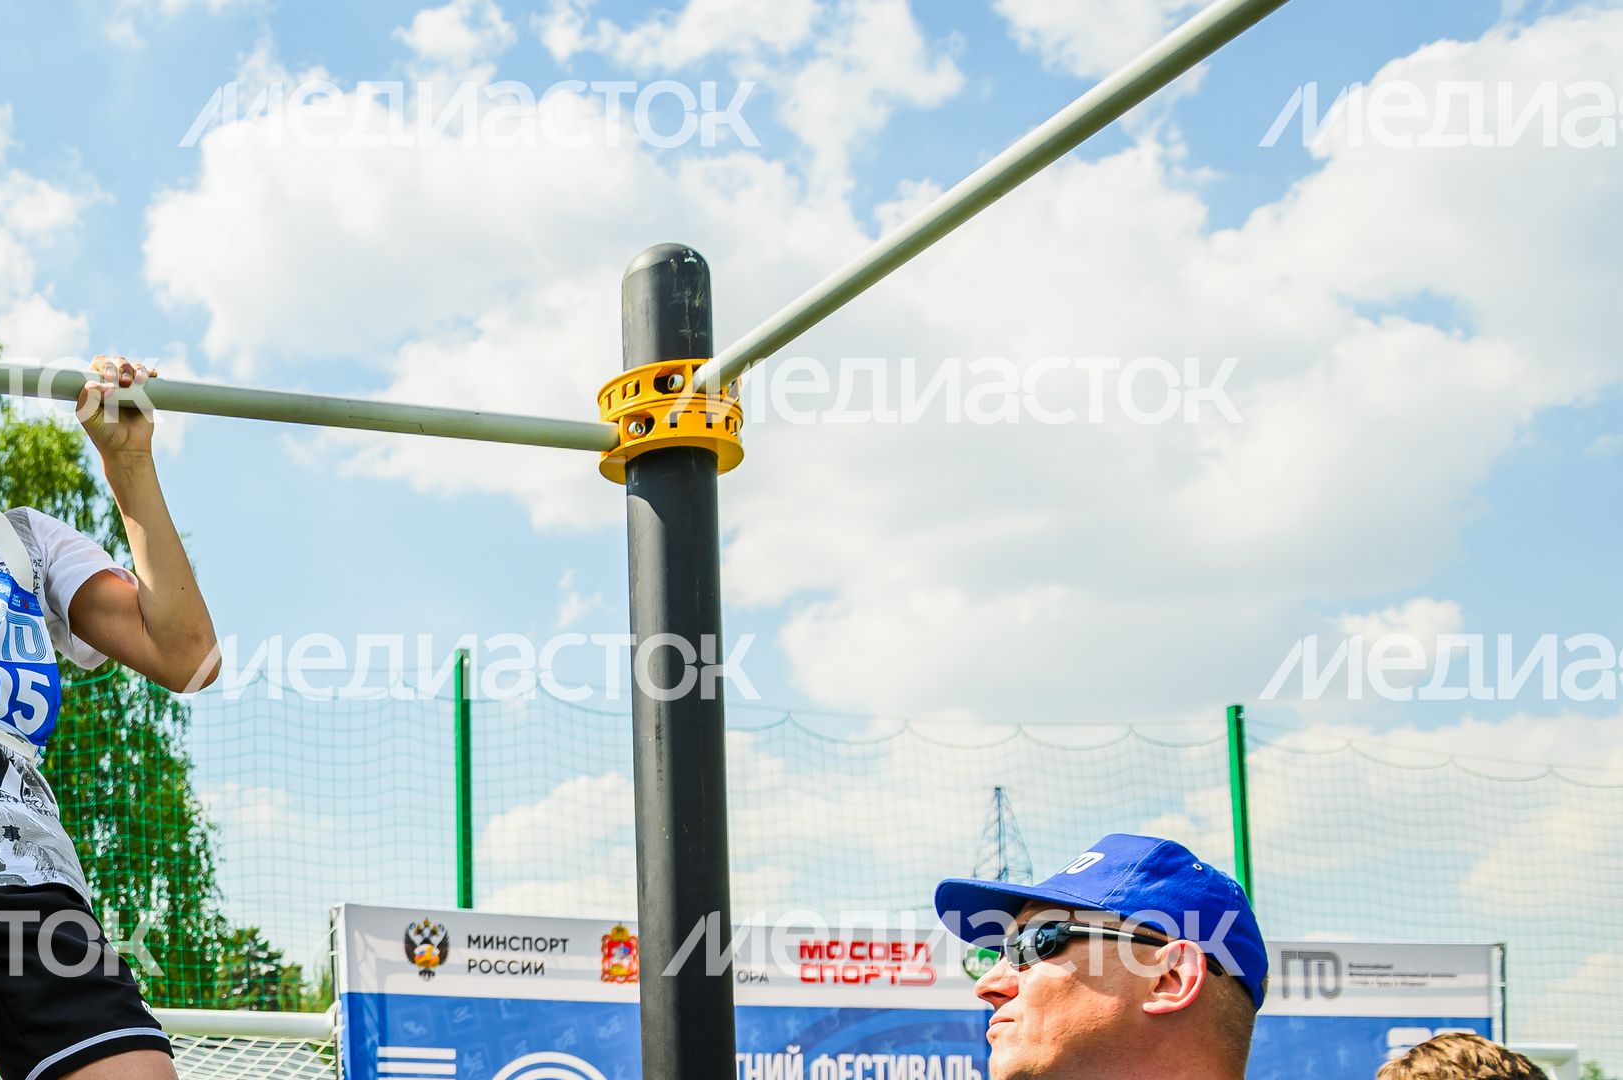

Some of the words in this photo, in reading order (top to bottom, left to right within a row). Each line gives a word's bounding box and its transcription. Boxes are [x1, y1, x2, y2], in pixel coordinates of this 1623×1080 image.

[467, 934, 569, 954] МИНСПОРТ
[799, 939, 931, 961] МОСОБЛ
[467, 959, 545, 976] РОССИИ
[800, 963, 902, 985] СПОРТ
[1281, 951, 1342, 1000] ГТО
